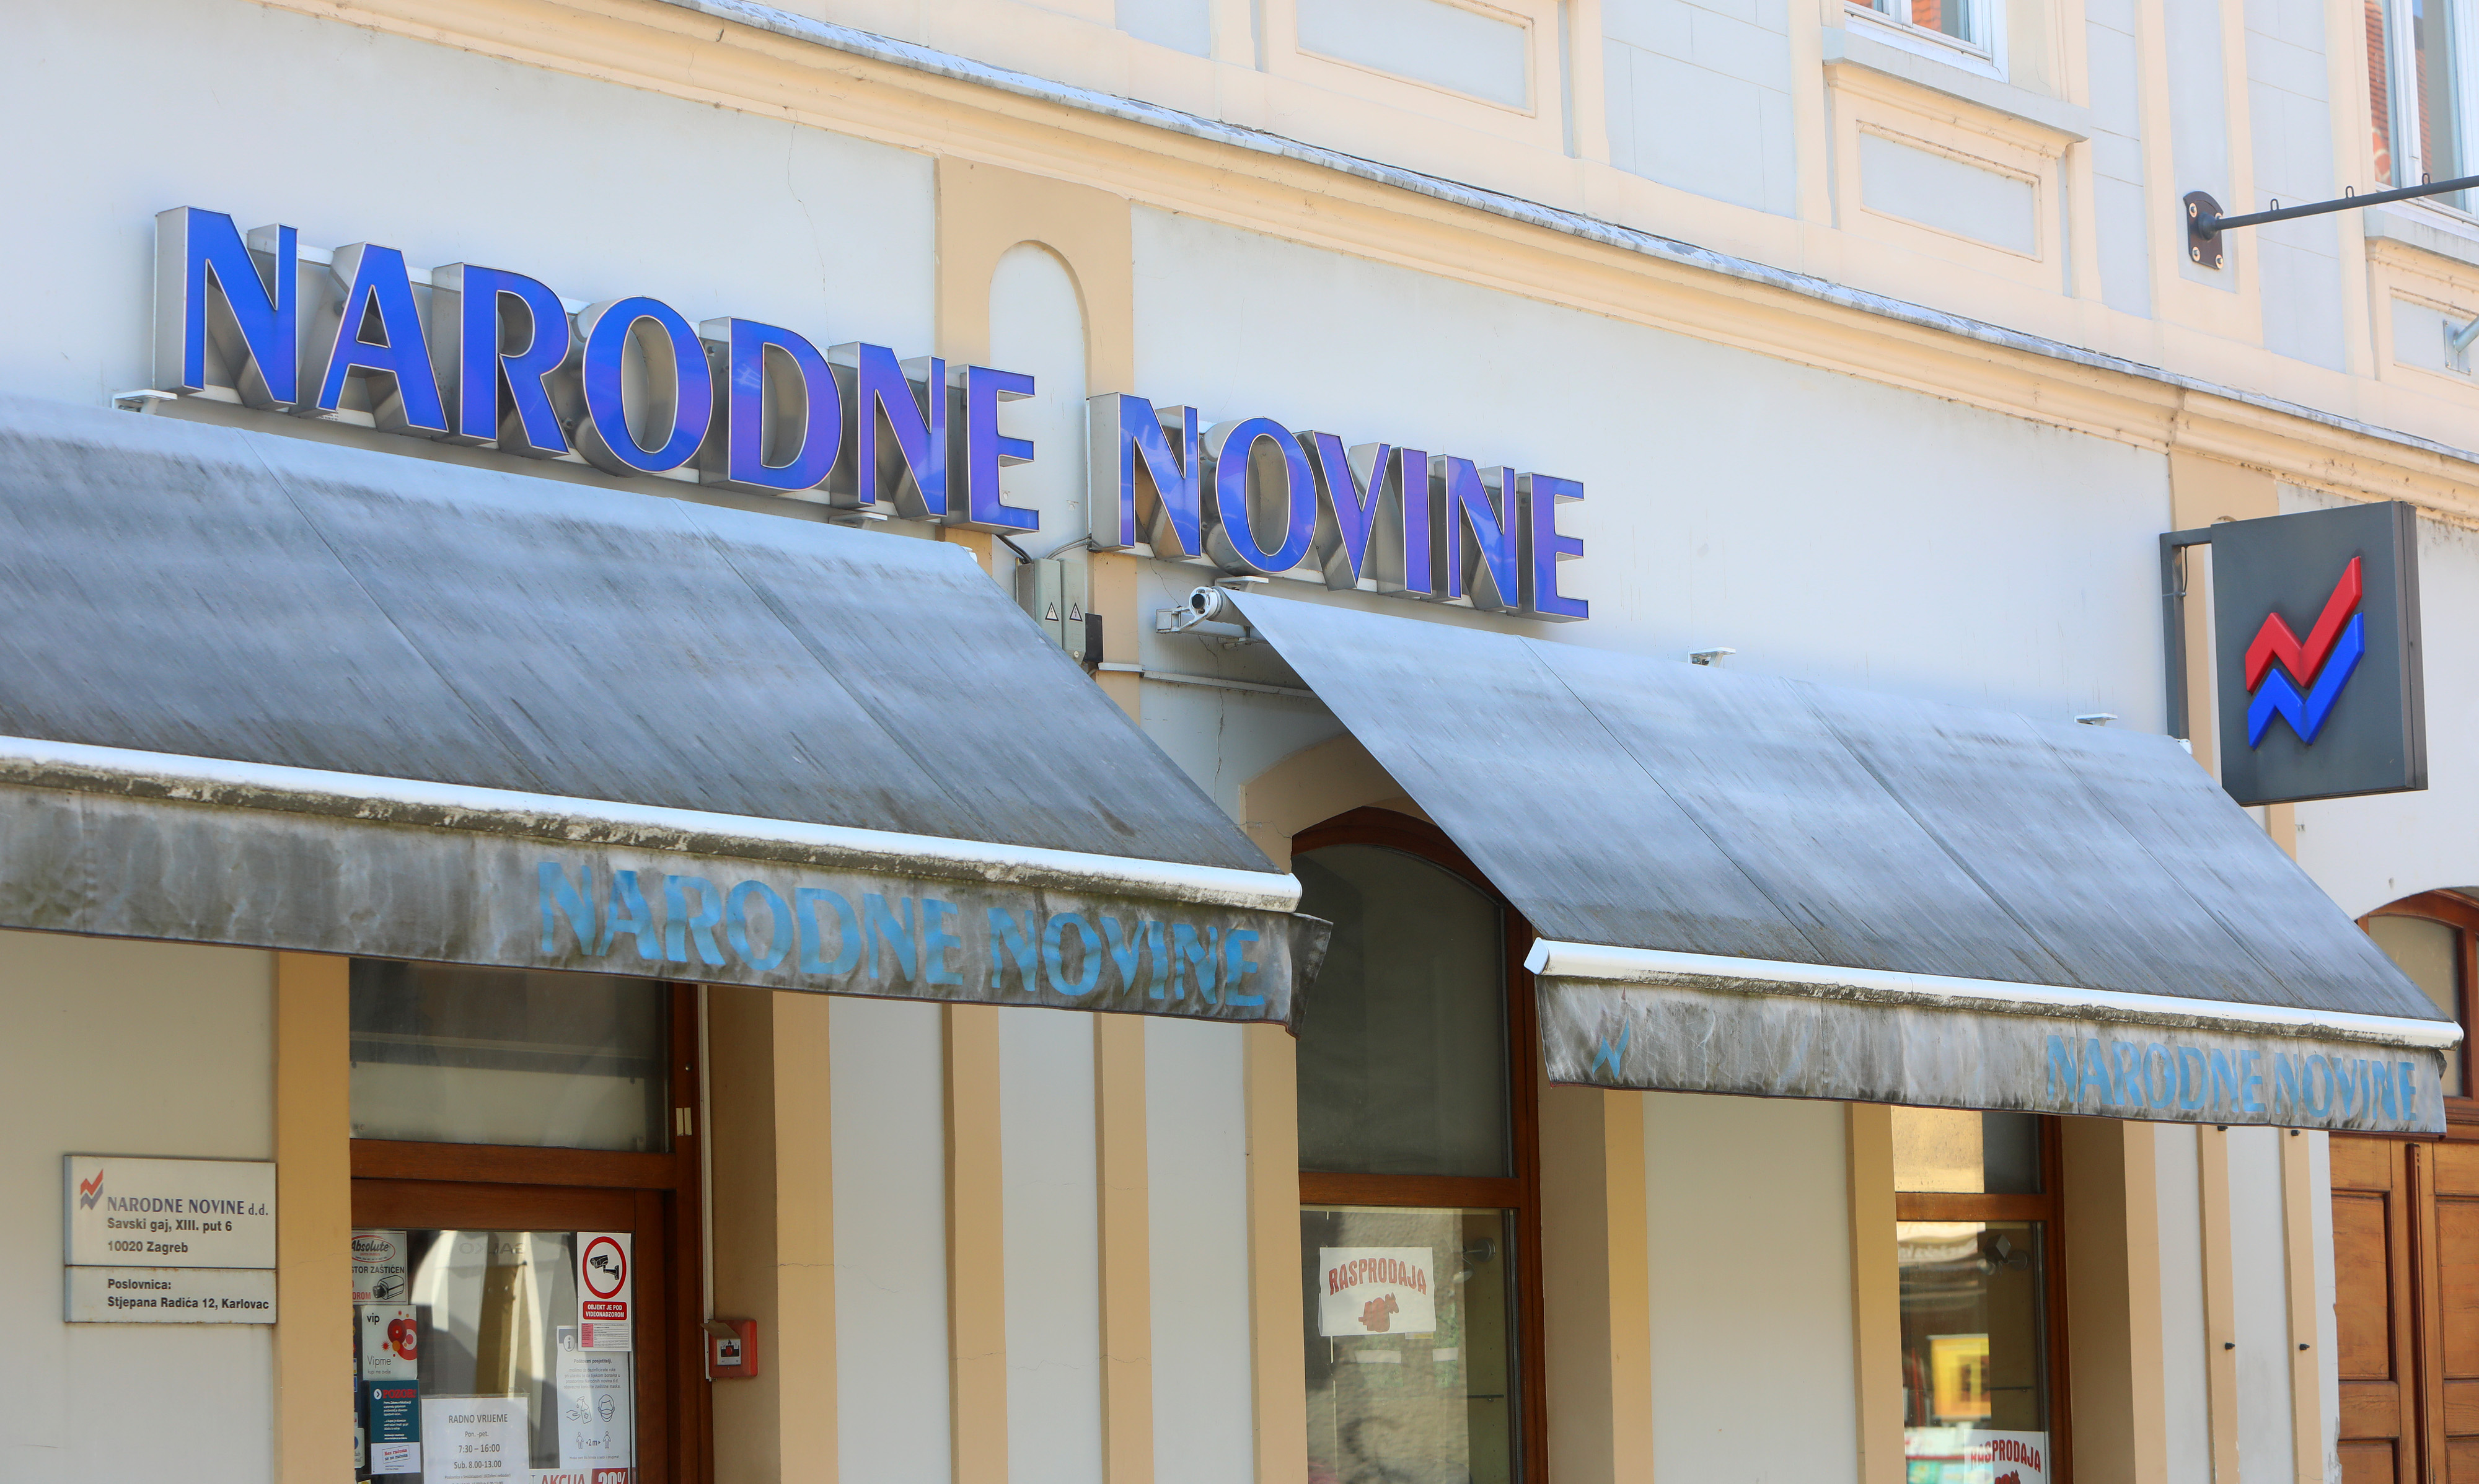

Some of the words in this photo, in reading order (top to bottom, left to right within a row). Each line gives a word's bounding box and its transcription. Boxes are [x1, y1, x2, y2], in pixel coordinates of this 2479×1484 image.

[182, 205, 1041, 535] NARODNE
[1119, 392, 1590, 620] NOVINE
[537, 861, 964, 986] NARODNE
[988, 907, 1266, 1008] NOVINE
[2046, 1034, 2265, 1113] NARODNE
[2274, 1052, 2418, 1122] NOVINE
[107, 1196, 183, 1213] NARODNE
[188, 1199, 244, 1214] NOVINE
[249, 1203, 268, 1216] d.d.
[107, 1218, 146, 1230] Savski
[151, 1219, 172, 1232] gaj,
[175, 1219, 199, 1231] XIII.
[203, 1221, 222, 1234] put
[225, 1221, 232, 1231] 6
[108, 1241, 143, 1252] 10020
[147, 1241, 188, 1255] Zagreb
[351, 1240, 389, 1252] Absolute
[371, 1265, 404, 1273] ZAŠTIĆEN
[1328, 1257, 1427, 1296] RASPRODAJA
[108, 1278, 172, 1290] Poslovnica:
[107, 1296, 157, 1310] Stjepana
[161, 1296, 198, 1308] Radića
[203, 1298, 218, 1310] 12,
[221, 1298, 269, 1309] Karlovac
[366, 1313, 380, 1325] vip
[367, 1355, 391, 1368] Vipme
[382, 1389, 416, 1398] POZOR!
[449, 1415, 475, 1423] RADNO
[477, 1414, 508, 1423] VRIJEME
[459, 1445, 473, 1453] 7:30
[480, 1444, 500, 1452] 16:00
[1971, 1439, 2041, 1473] RASPRODAJA
[469, 1460, 502, 1469] 8.00-13.00
